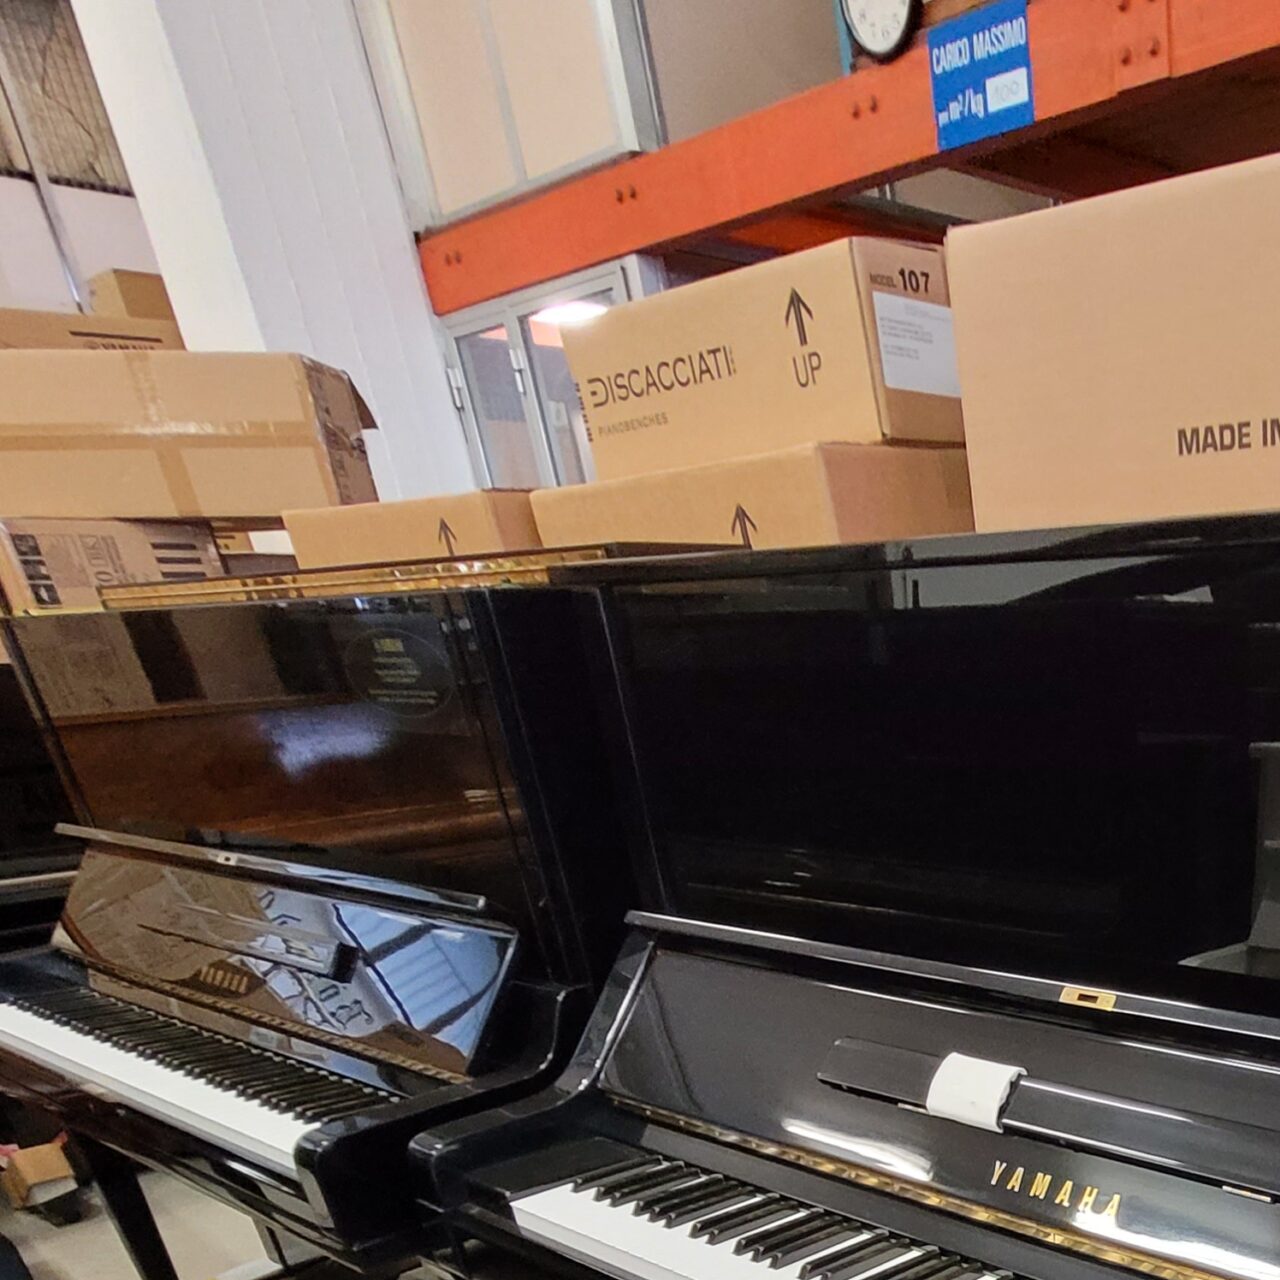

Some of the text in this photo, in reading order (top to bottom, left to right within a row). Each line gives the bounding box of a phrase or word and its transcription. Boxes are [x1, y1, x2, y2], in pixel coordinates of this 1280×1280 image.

[932, 16, 1026, 75] CARICO MASSIMO
[899, 267, 930, 294] 107
[793, 351, 822, 388] UP
[598, 412, 669, 436] PIANOBENCHES
[1177, 421, 1251, 456] MADE
[990, 1160, 1121, 1217] YAMAHA
